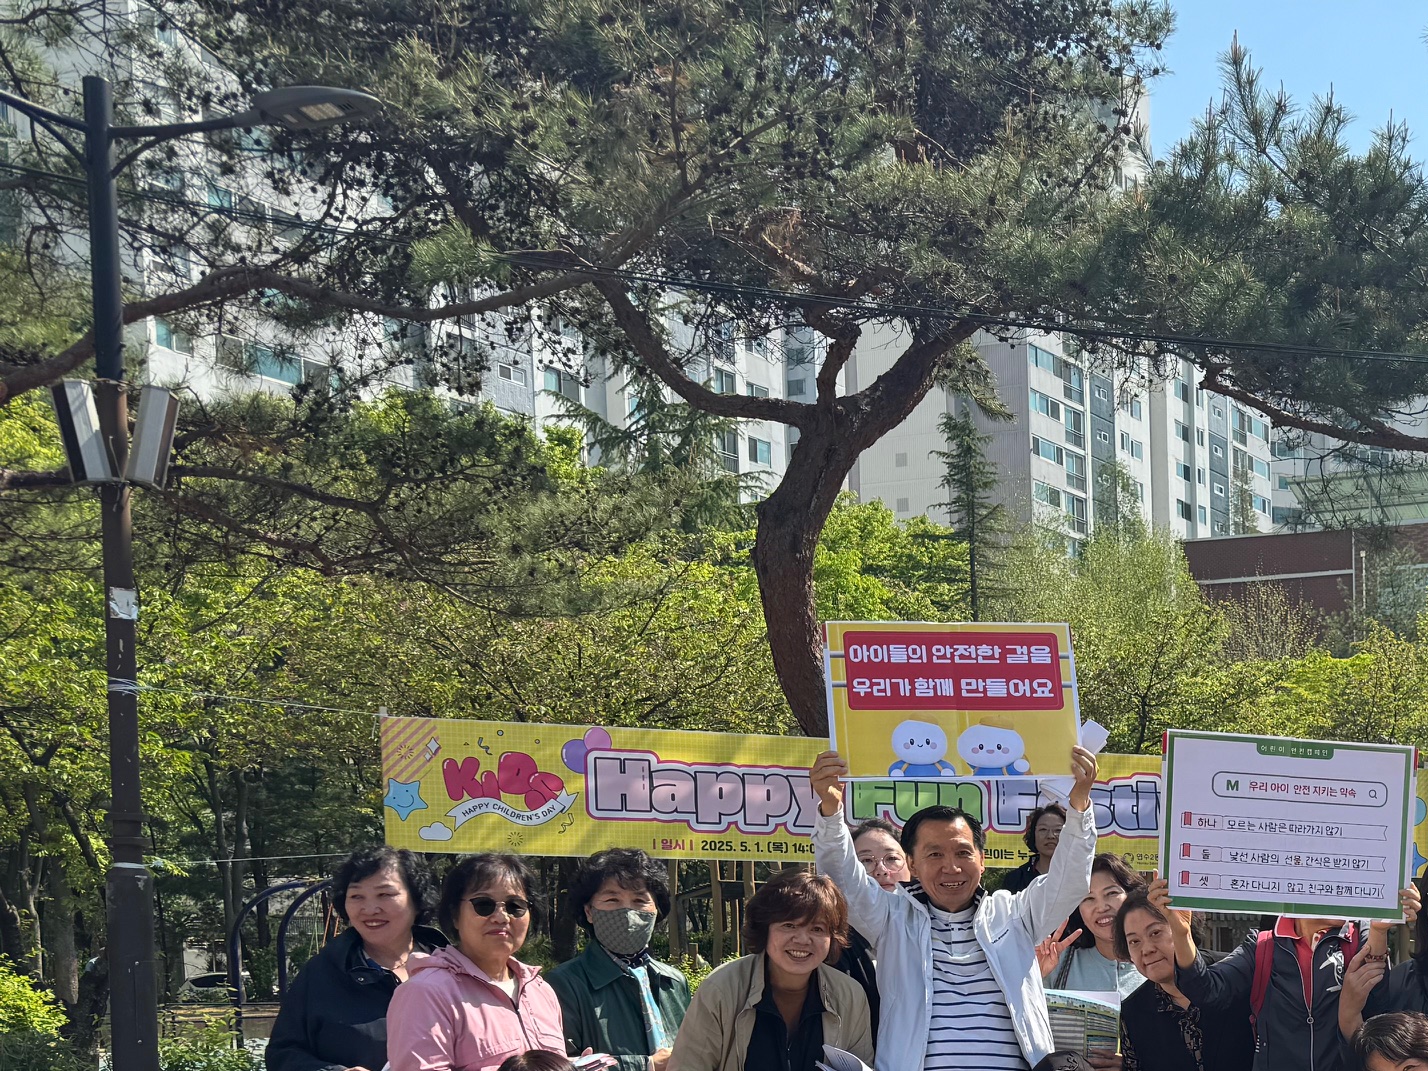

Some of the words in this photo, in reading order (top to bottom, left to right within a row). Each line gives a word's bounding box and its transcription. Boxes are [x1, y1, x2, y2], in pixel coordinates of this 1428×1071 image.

[849, 645, 927, 663] 아이들의
[932, 645, 1001, 664] 안전한
[1006, 646, 1051, 664] 걸음
[852, 679, 911, 697] 우리가
[915, 677, 954, 697] 함께
[961, 679, 1054, 697] 만들어요
[594, 757, 817, 827] Happy
[1226, 780, 1239, 791] M
[1249, 780, 1268, 792] 우리
[1270, 782, 1289, 794] 아이
[1293, 784, 1310, 796] 안전
[1313, 785, 1337, 798] 지키는
[1339, 786, 1356, 799] 약속
[462, 802, 490, 818] HAPPY
[492, 803, 541, 822] CHILDREN'S
[541, 805, 556, 818] DAY
[1197, 817, 1217, 828] 하나
[1227, 819, 1255, 832] 모르는
[1258, 821, 1287, 833] 사람은
[1289, 824, 1323, 835] 따라가지
[1325, 825, 1343, 837] 않기
[661, 839, 685, 850] 일시
[701, 840, 736, 852] 2025.
[740, 841, 753, 852] 5.
[754, 841, 763, 852] 1.
[767, 841, 788, 854] (목)
[1201, 849, 1211, 860] 둘
[1251, 852, 1279, 865] 사람의
[1305, 856, 1331, 868] 간식은
[1333, 857, 1350, 869] 받지
[1352, 858, 1369, 870] 않기
[1199, 876, 1209, 887] 셋
[1230, 878, 1250, 890] 혼자
[1251, 880, 1280, 892] 다니지
[1287, 882, 1305, 894] 않고
[1308, 883, 1334, 895] 친구와
[1336, 885, 1352, 897] 함께
[1354, 885, 1380, 897] 다니기
